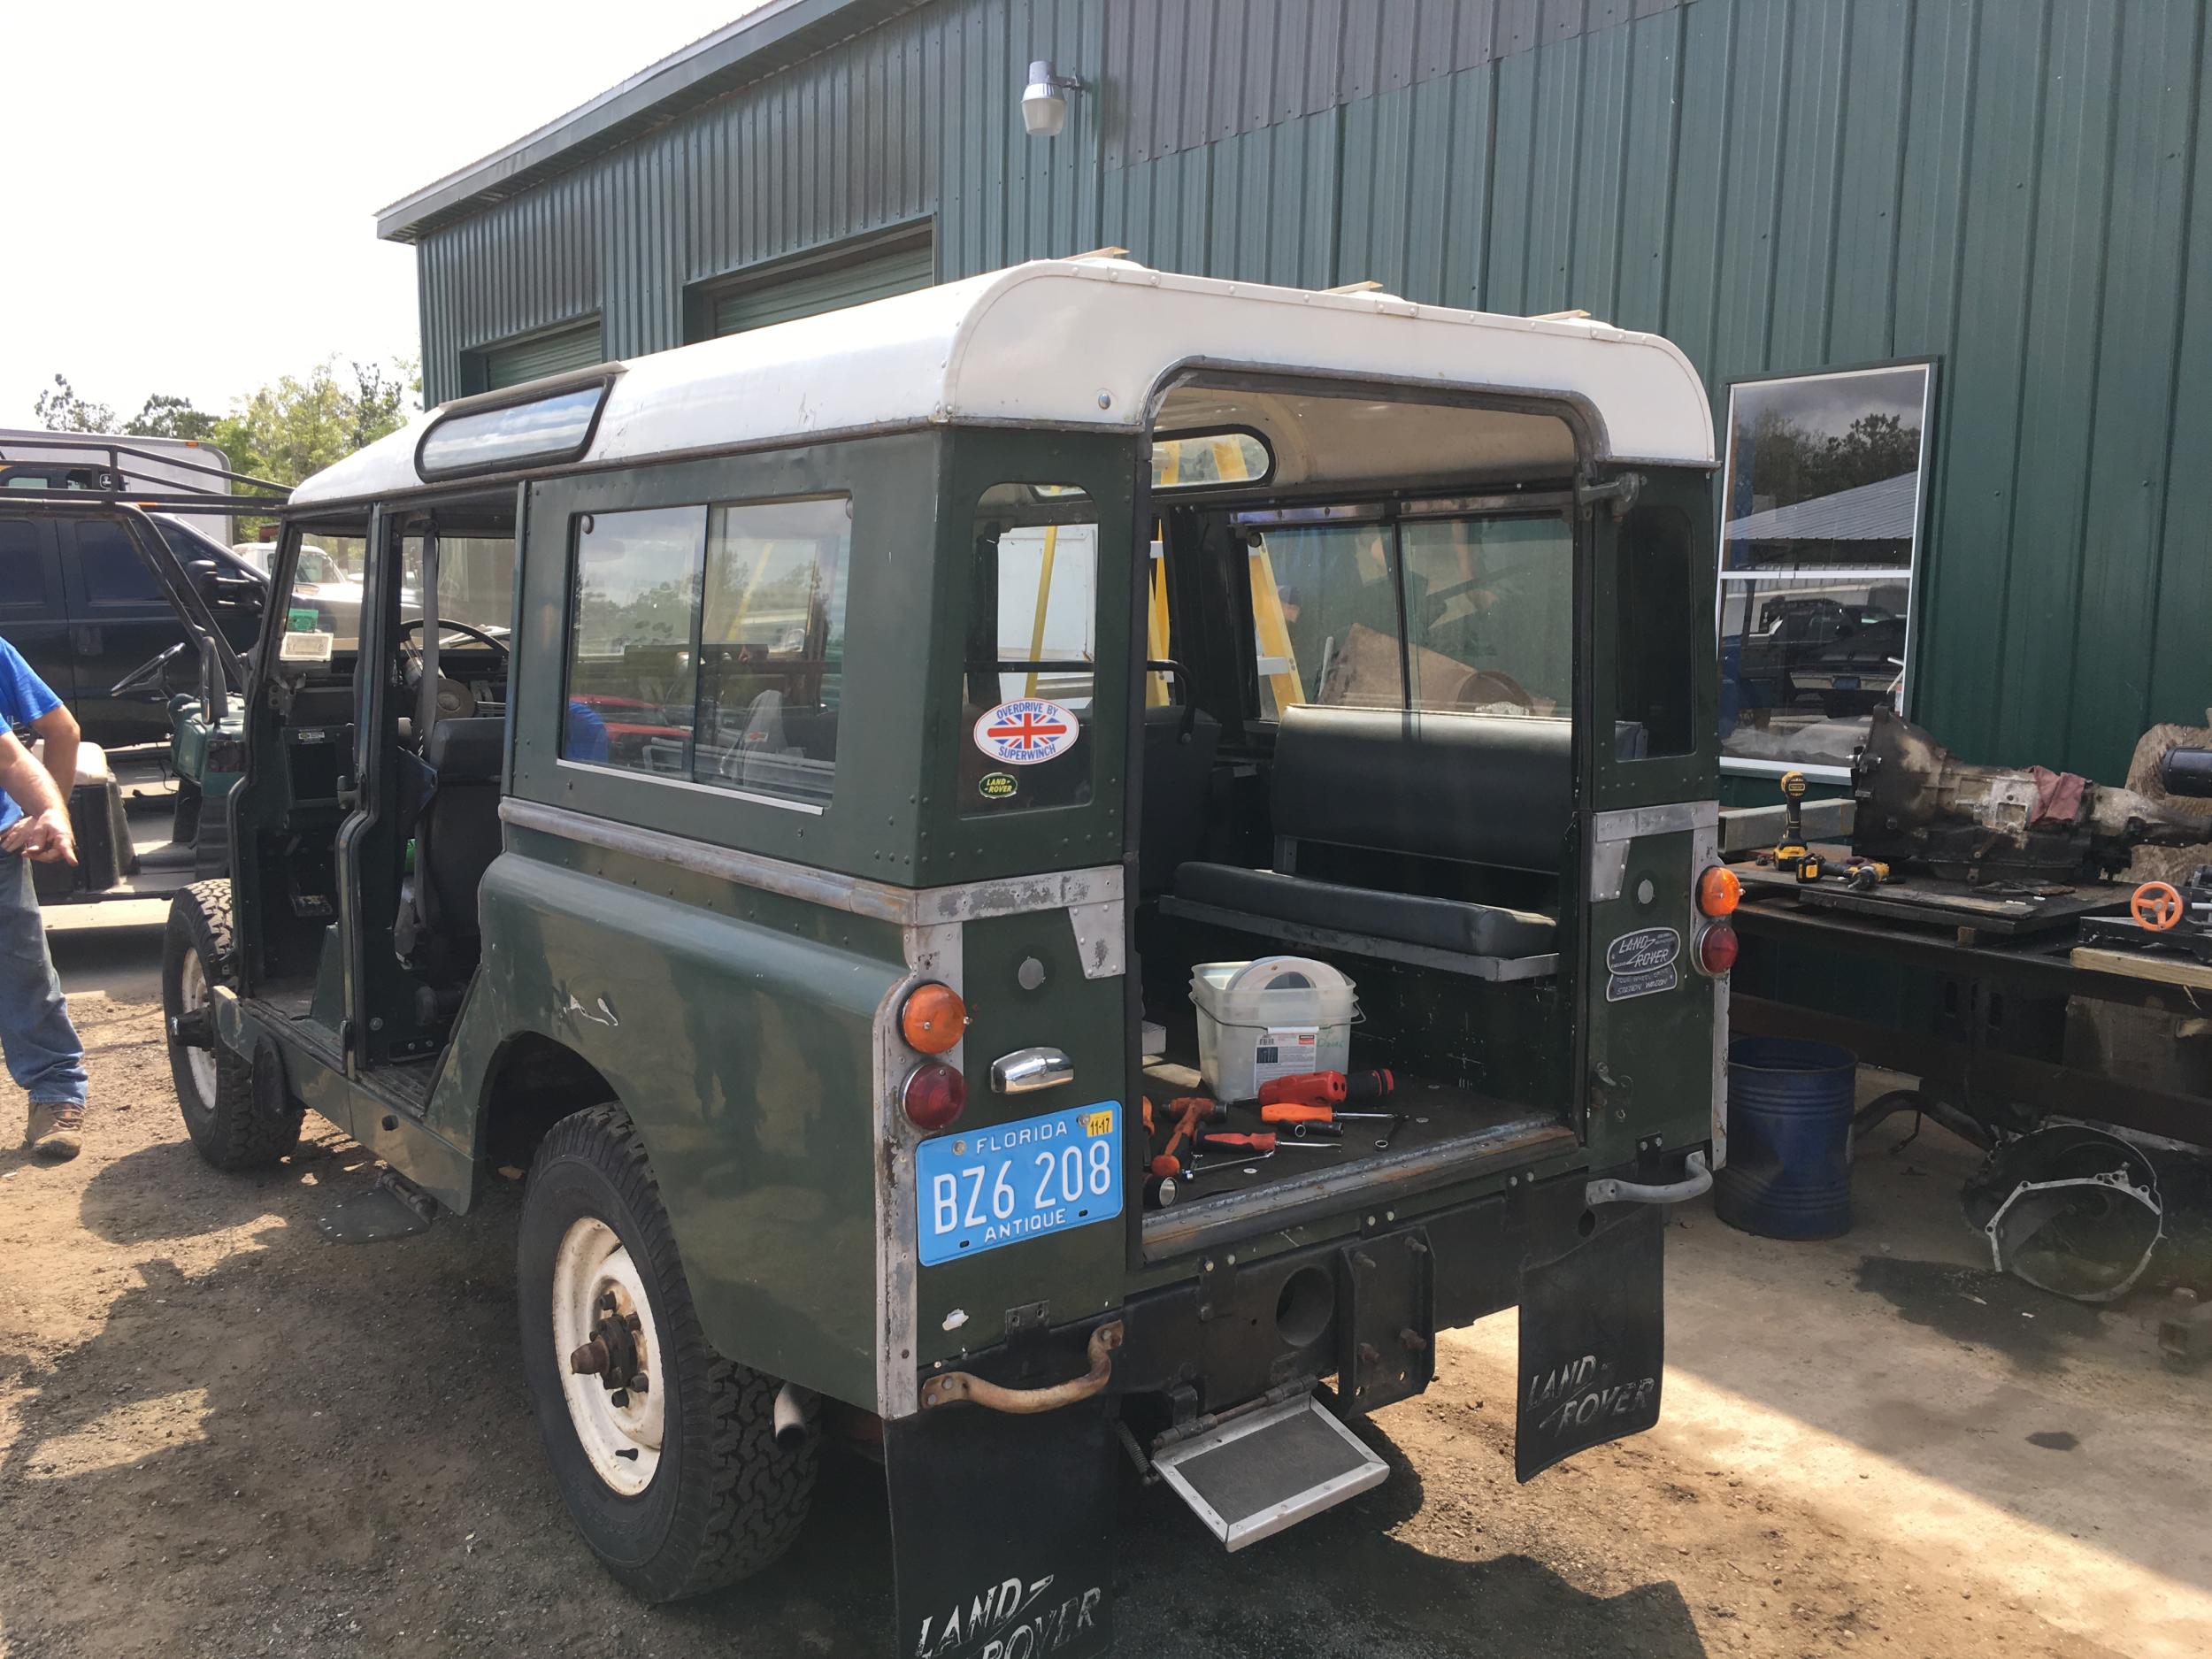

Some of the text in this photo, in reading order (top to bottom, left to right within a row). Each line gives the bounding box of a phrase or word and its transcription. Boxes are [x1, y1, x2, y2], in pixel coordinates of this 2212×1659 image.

[996, 702, 1059, 719] OVERDRIVE BY
[998, 744, 1056, 761] SUPERWINCH
[1634, 949, 1669, 967] ROVER
[1617, 983, 1642, 995] STATION
[976, 1121, 1068, 1155] FLORIDA
[933, 1141, 1112, 1236] BZ6 208
[984, 1208, 1067, 1243] ANTIQUE
[1555, 1378, 1655, 1437] ROVER
